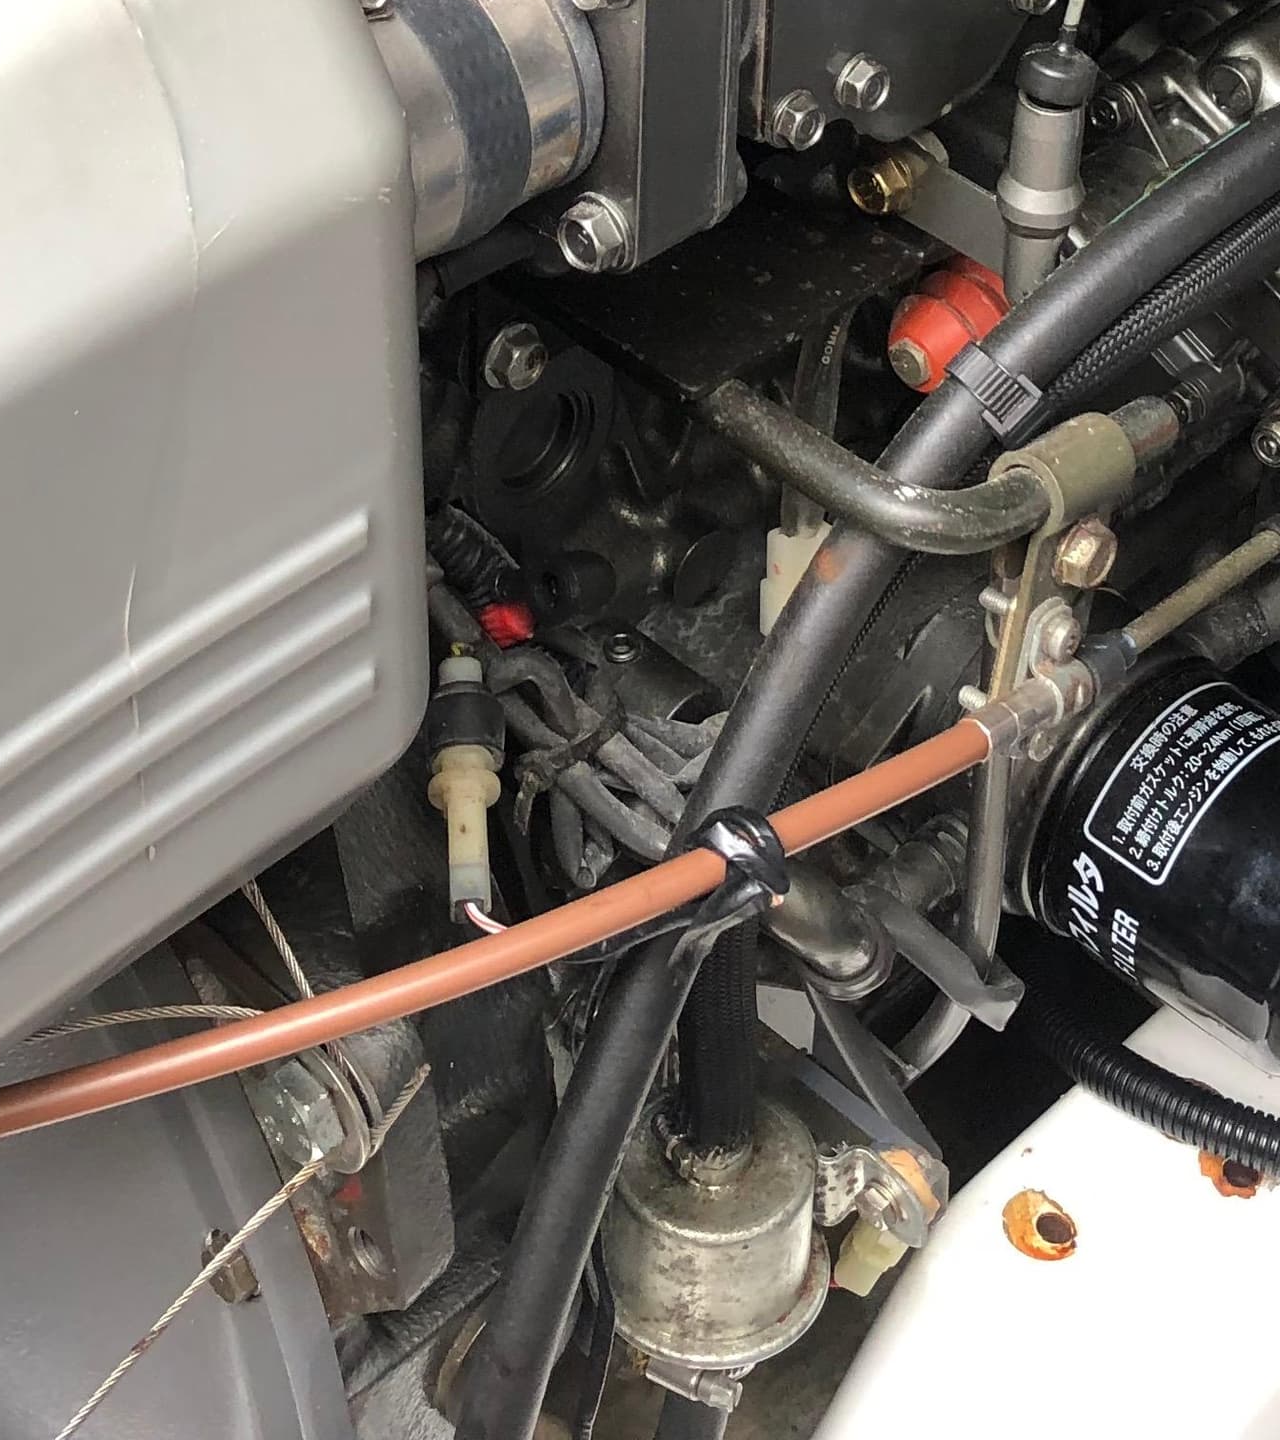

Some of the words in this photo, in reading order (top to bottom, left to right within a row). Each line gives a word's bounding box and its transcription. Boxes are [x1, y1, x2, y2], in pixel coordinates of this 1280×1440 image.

[1129, 703, 1199, 773] 交換時の注意
